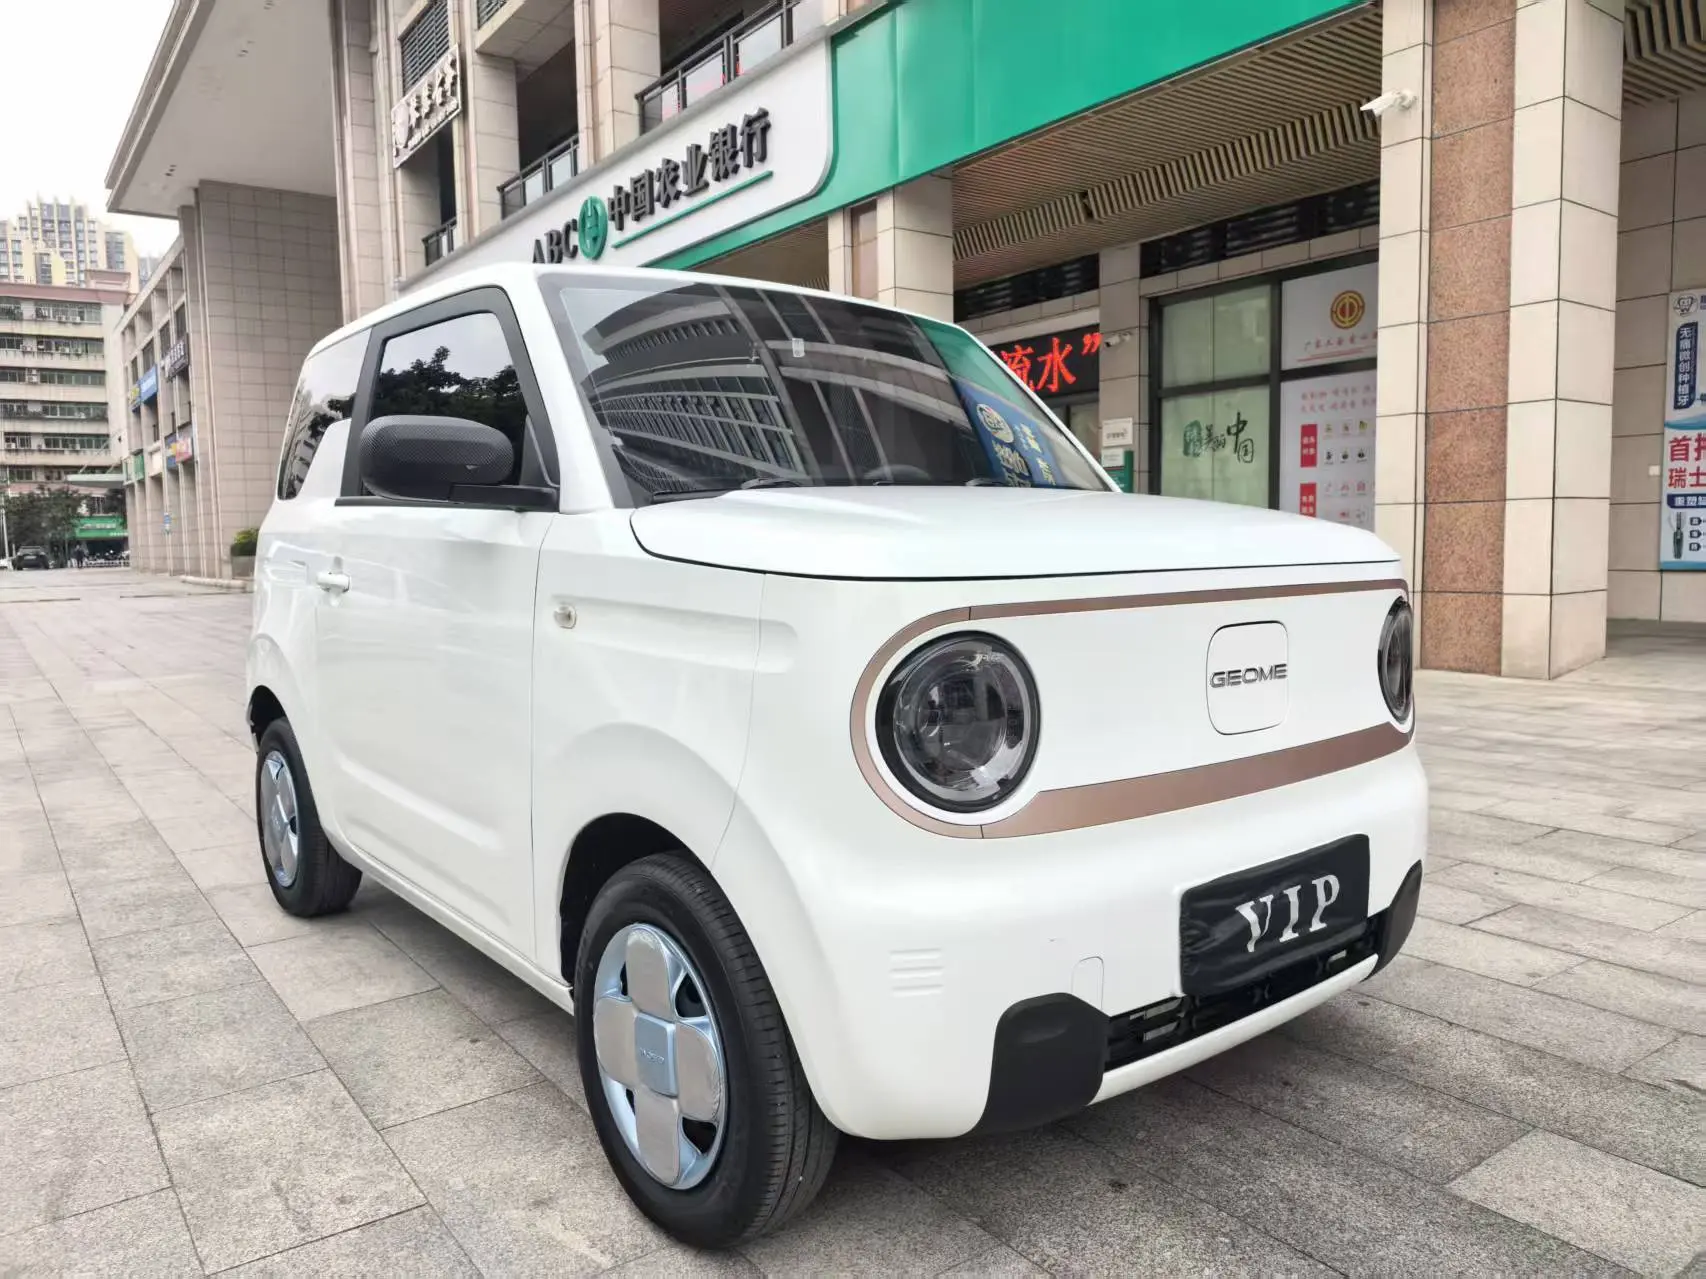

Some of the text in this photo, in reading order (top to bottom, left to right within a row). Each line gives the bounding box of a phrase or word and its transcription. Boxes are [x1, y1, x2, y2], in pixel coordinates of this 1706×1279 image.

[532, 107, 772, 264] ABC 中国农业银行
[1210, 663, 1288, 689] GEOME
[1235, 874, 1341, 953] VIP
